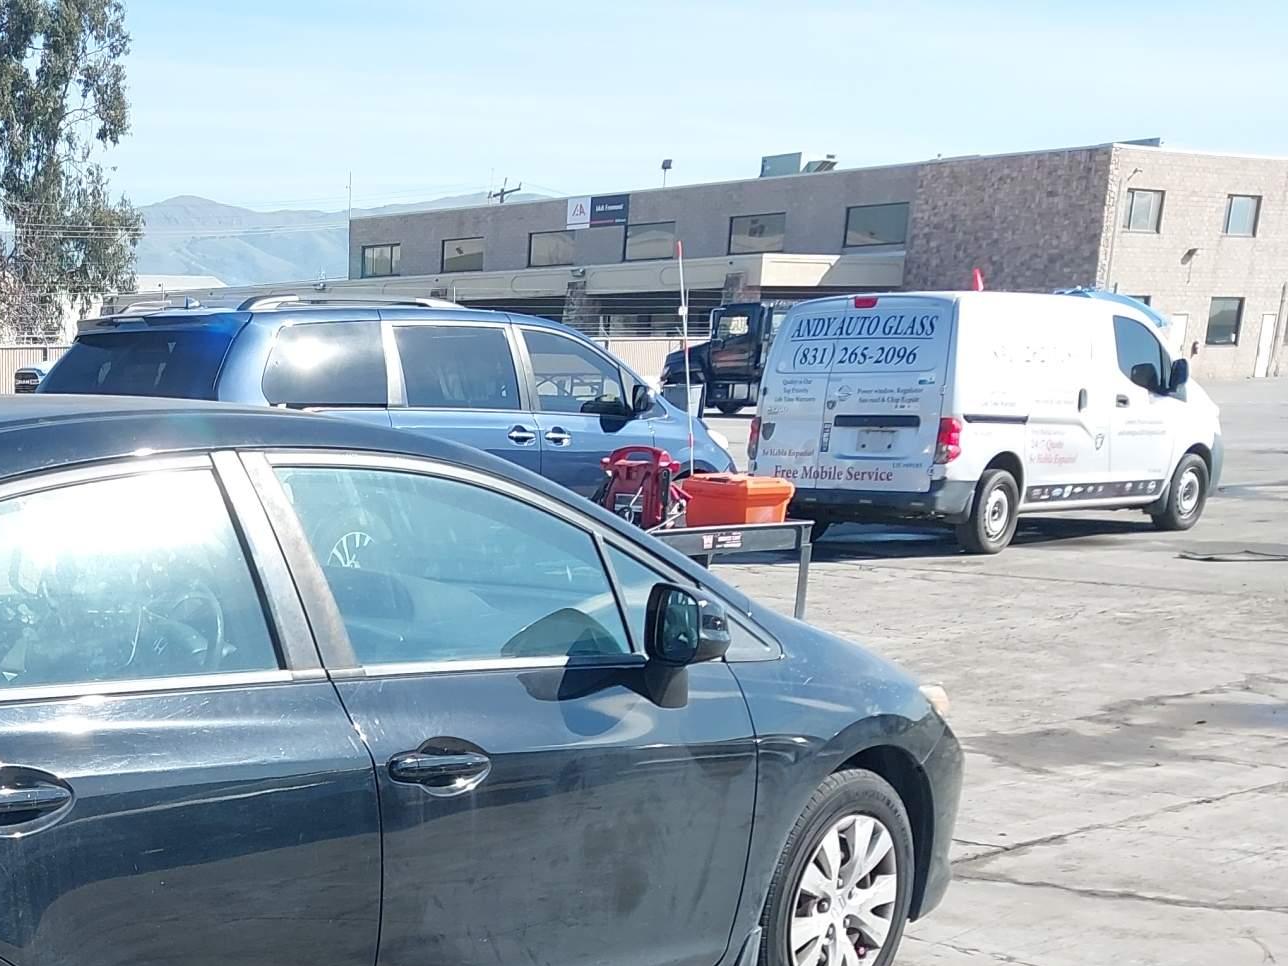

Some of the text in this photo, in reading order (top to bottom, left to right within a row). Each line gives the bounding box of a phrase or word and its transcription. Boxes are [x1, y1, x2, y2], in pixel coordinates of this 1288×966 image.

[791, 315, 939, 338] ANDY AUTO GLASS
[793, 343, 919, 370] (831) 265-2096
[774, 465, 798, 480] Free
[801, 465, 843, 481] Mobile
[845, 466, 894, 482] Service
